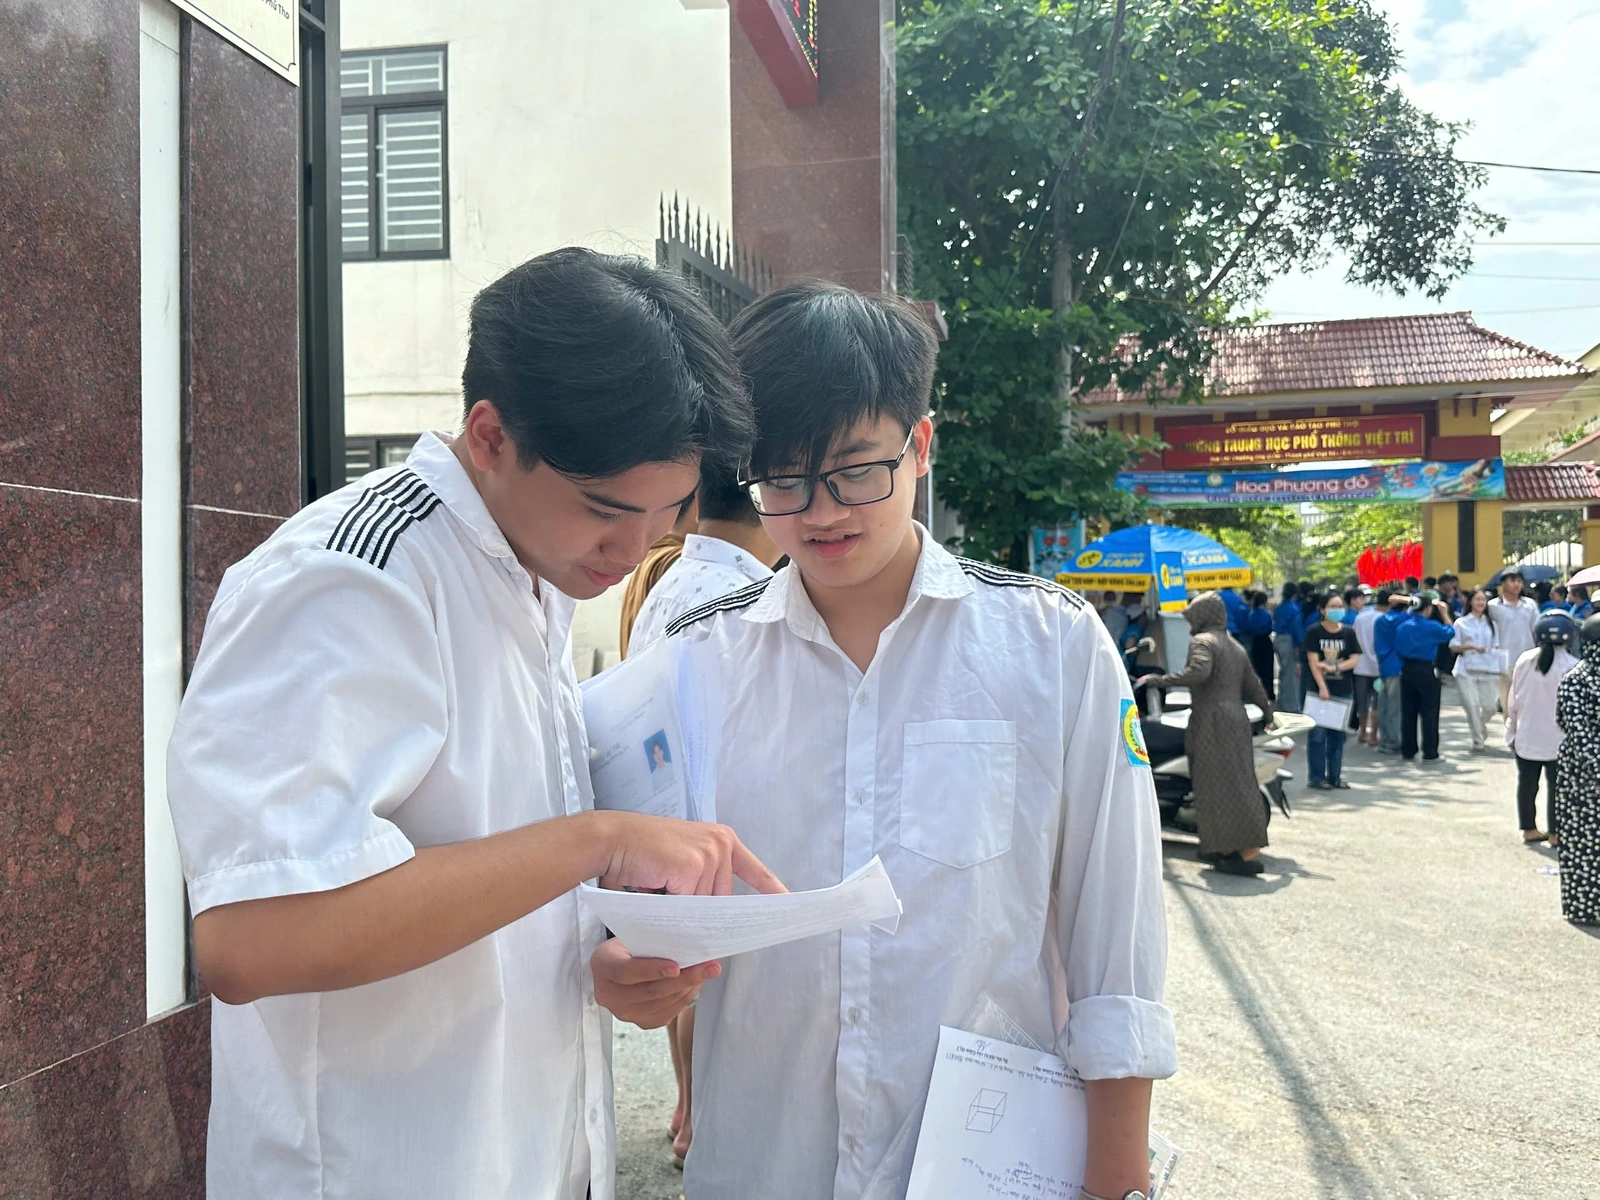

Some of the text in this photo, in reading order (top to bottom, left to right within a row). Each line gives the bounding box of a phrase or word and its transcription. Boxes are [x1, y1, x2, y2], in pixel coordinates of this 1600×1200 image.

[1223, 438, 1262, 453] TRUNG
[1265, 436, 1291, 455] HỌC
[1292, 430, 1319, 450] PHỔ
[1320, 430, 1361, 449] THÔNG
[1364, 429, 1392, 448] VIỆT
[1394, 428, 1414, 444] TRÌ
[1235, 474, 1369, 494] Hoa Phượng đỏ
